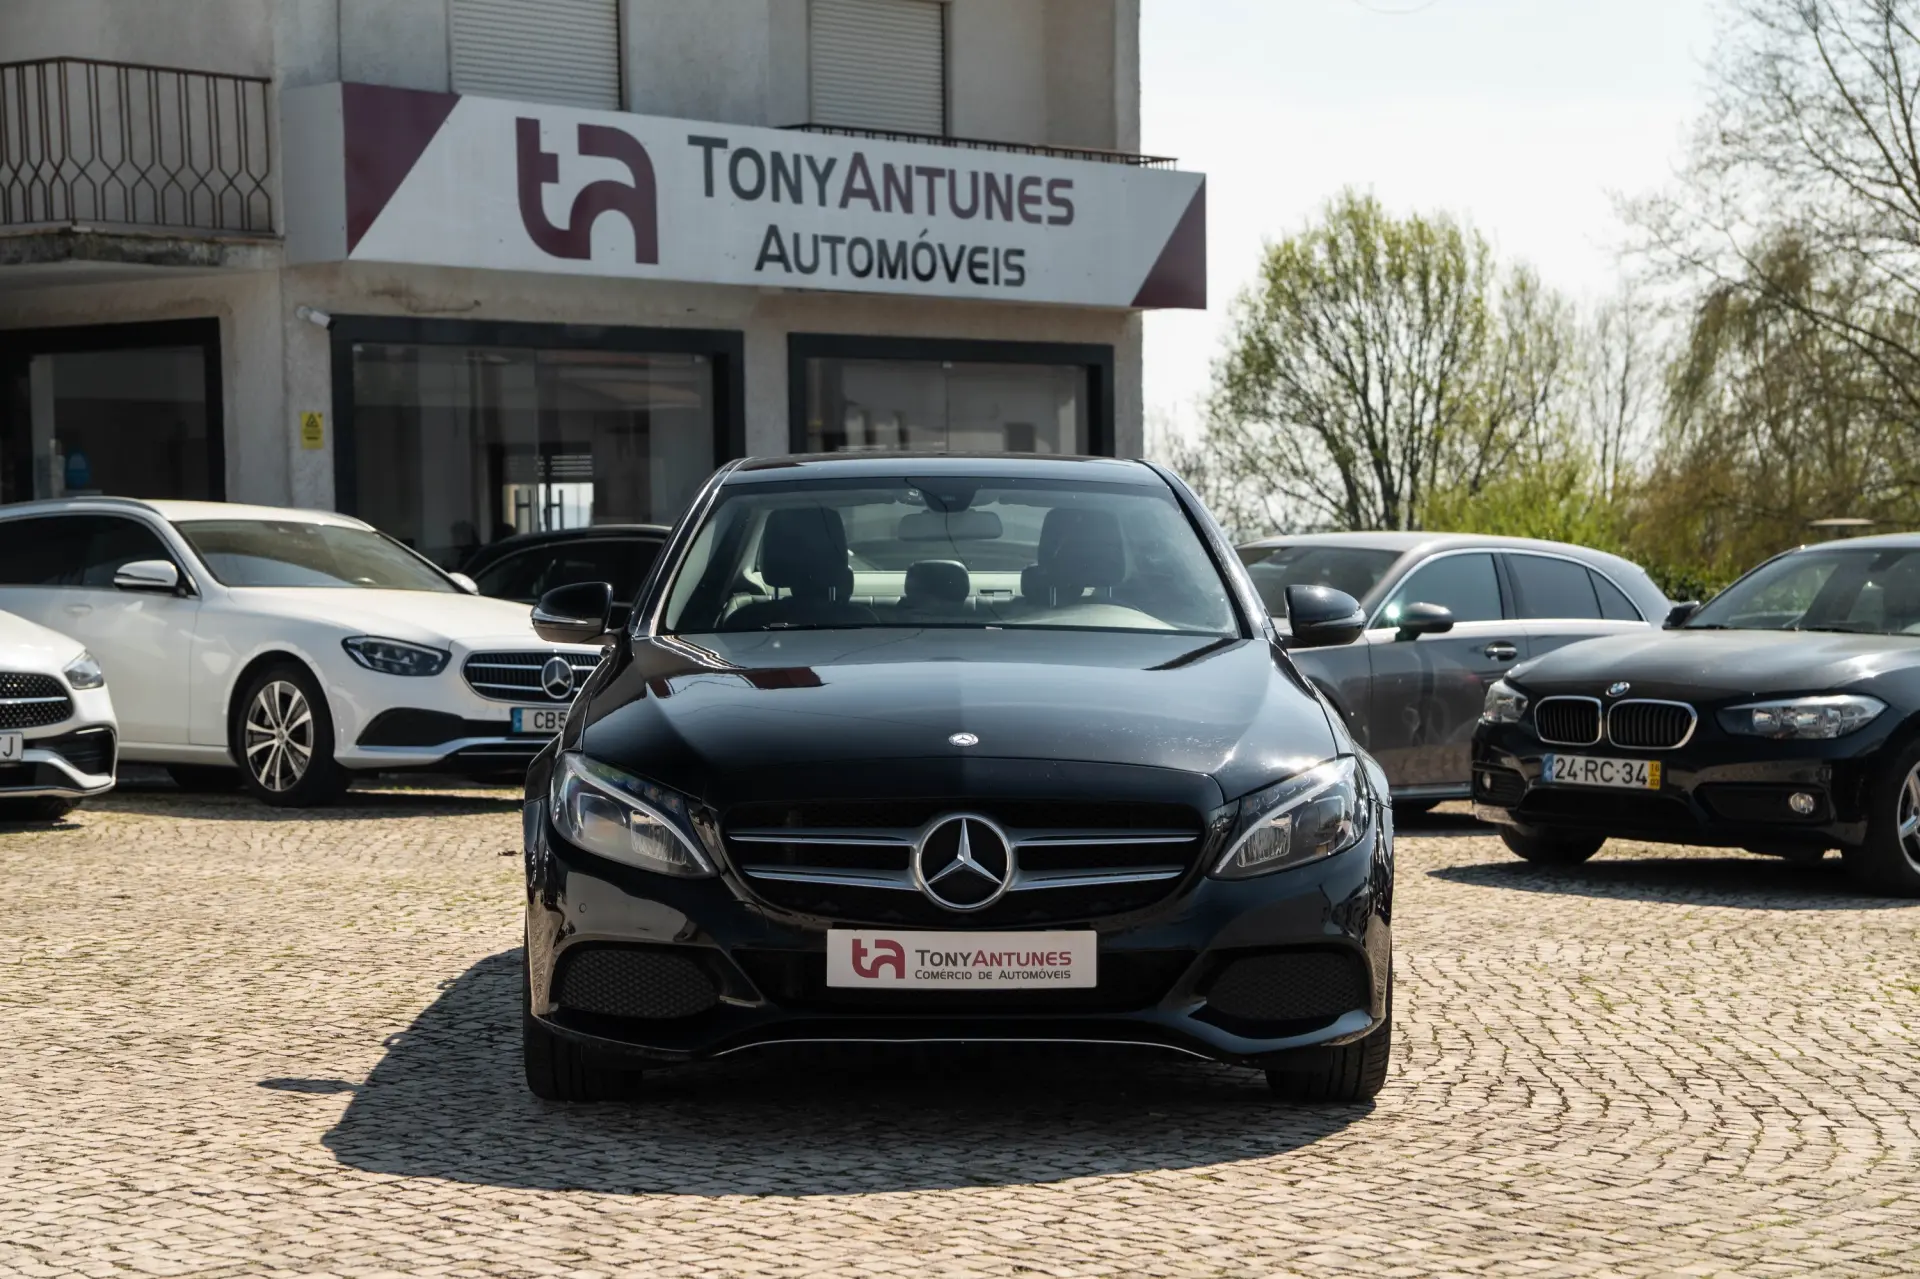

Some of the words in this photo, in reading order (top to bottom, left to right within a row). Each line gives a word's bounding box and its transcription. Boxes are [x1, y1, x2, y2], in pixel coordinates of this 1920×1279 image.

[754, 224, 1026, 286] AUTOMÓVEIS
[0, 736, 13, 757] J
[914, 968, 972, 980] COMÉRCIO
[978, 969, 992, 980] DE
[998, 968, 1071, 980] AUTOMÓVEIS
